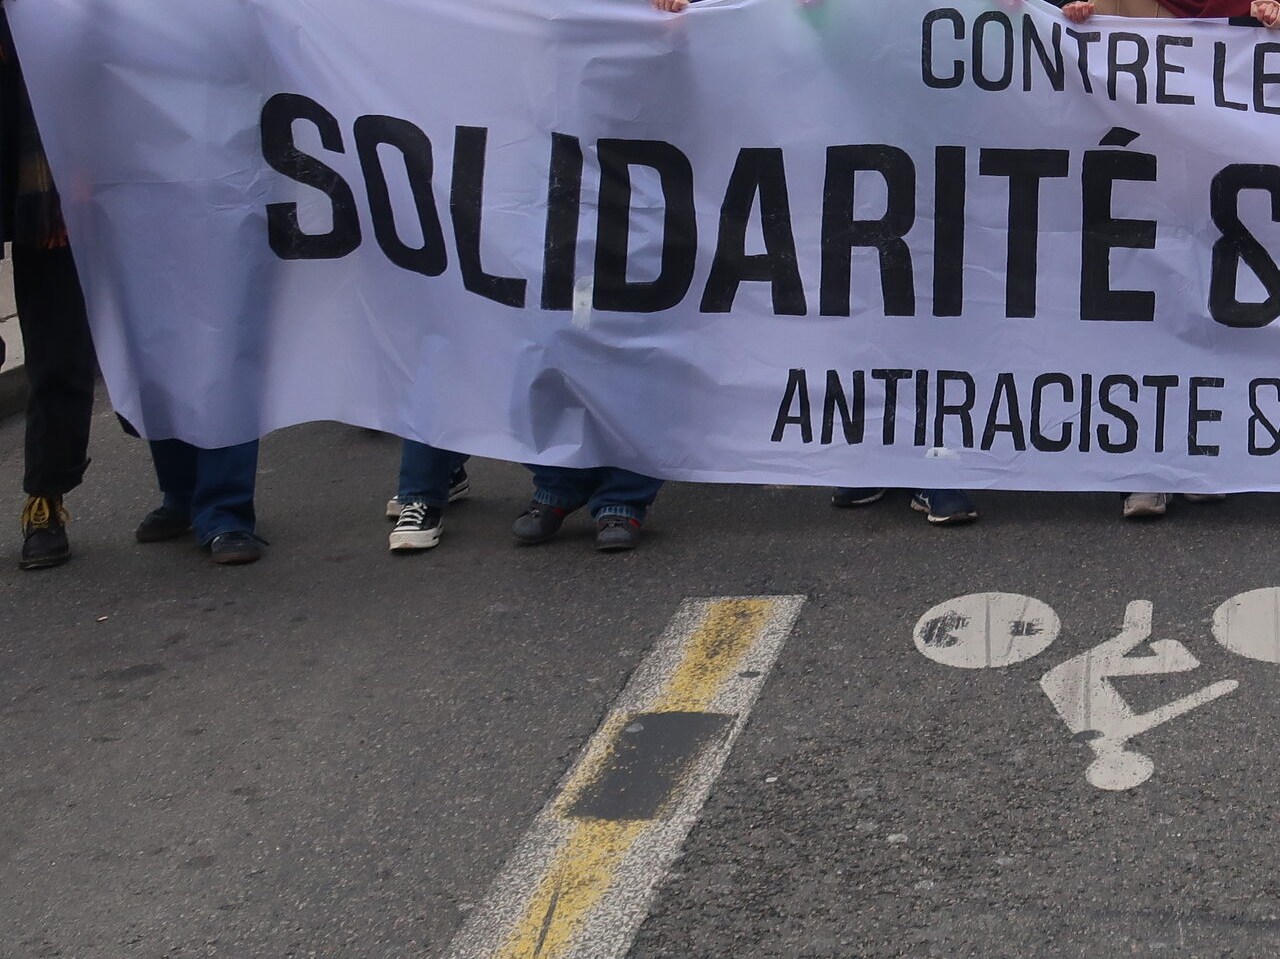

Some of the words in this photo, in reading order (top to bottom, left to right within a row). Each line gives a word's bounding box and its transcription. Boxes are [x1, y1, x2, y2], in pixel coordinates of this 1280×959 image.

[923, 8, 1195, 105] CONTRE
[261, 93, 1158, 321] SOLIDARITÉ
[771, 368, 1224, 456] ANTIRACISTE
